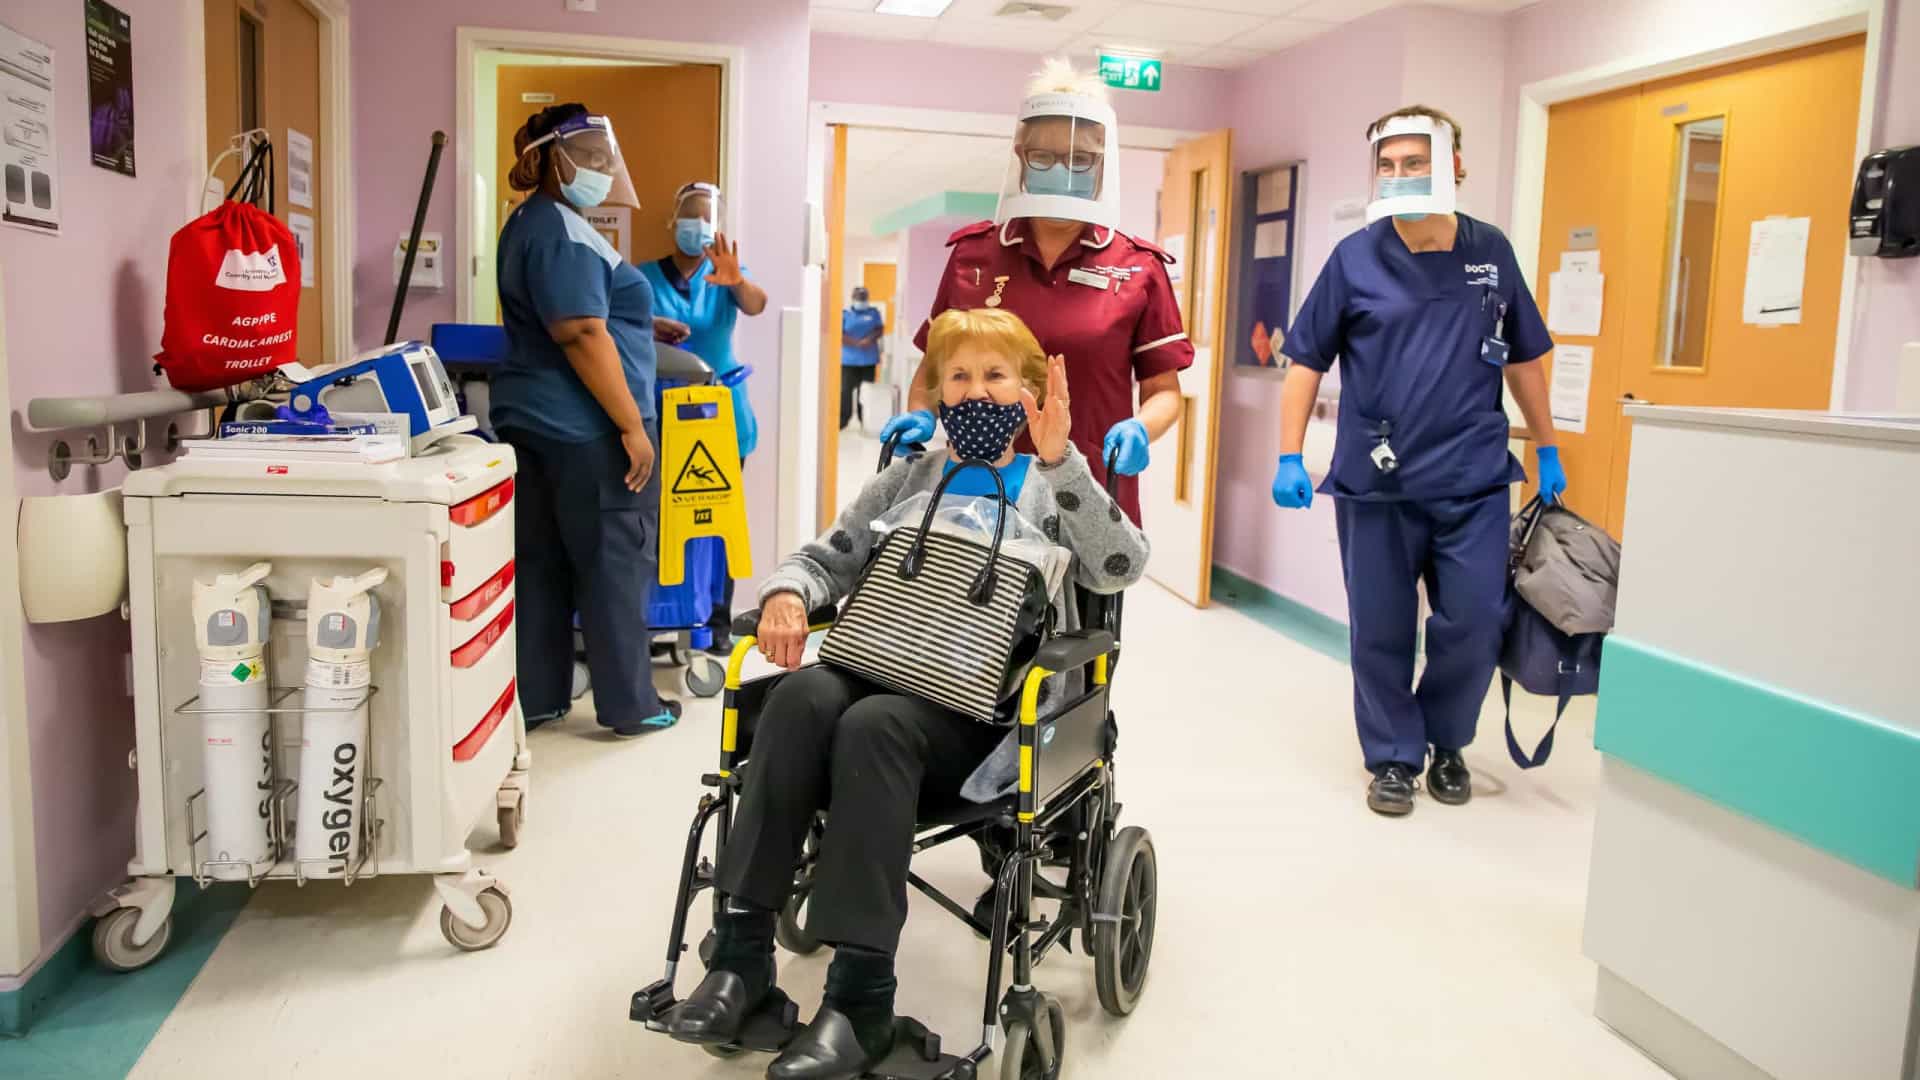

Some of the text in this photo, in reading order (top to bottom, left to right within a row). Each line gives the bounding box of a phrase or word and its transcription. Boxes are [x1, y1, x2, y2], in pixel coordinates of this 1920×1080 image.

[587, 215, 618, 225] TOILET
[202, 329, 293, 349] CARDIAC ARREST
[224, 355, 273, 369] TROLLEY
[225, 424, 268, 434] Sonic 200
